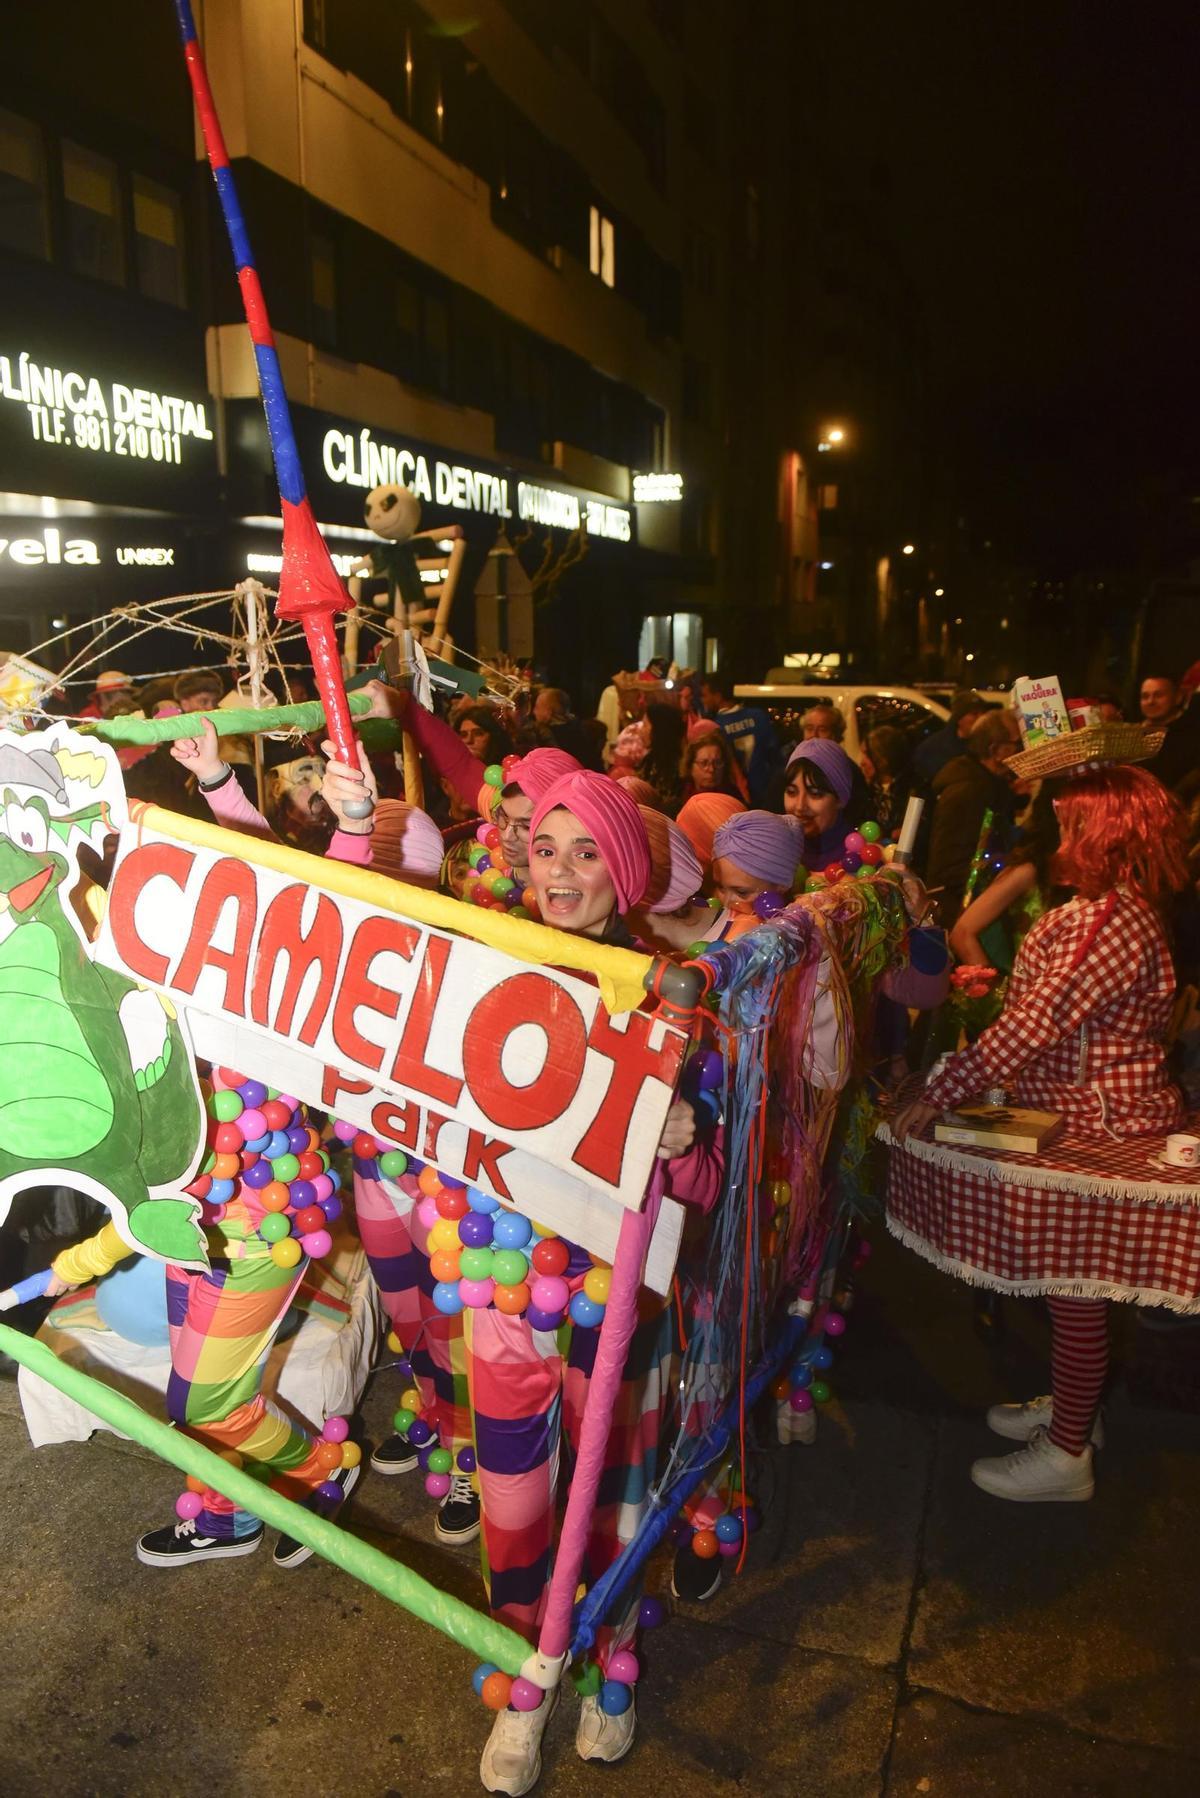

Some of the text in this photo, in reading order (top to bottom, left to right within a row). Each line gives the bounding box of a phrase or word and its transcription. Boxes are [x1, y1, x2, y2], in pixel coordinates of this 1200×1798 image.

[0, 352, 213, 440] LÍNICA DENTAL
[27, 403, 182, 465] TLF. 981 210 011
[323, 428, 432, 503] CLÍNICA
[436, 461, 512, 518] DENTAL
[116, 548, 175, 566] UNISEX
[1020, 688, 1058, 702] VAQUERA
[1031, 683, 1042, 692] LA
[110, 842, 686, 1188] CAMELOT
